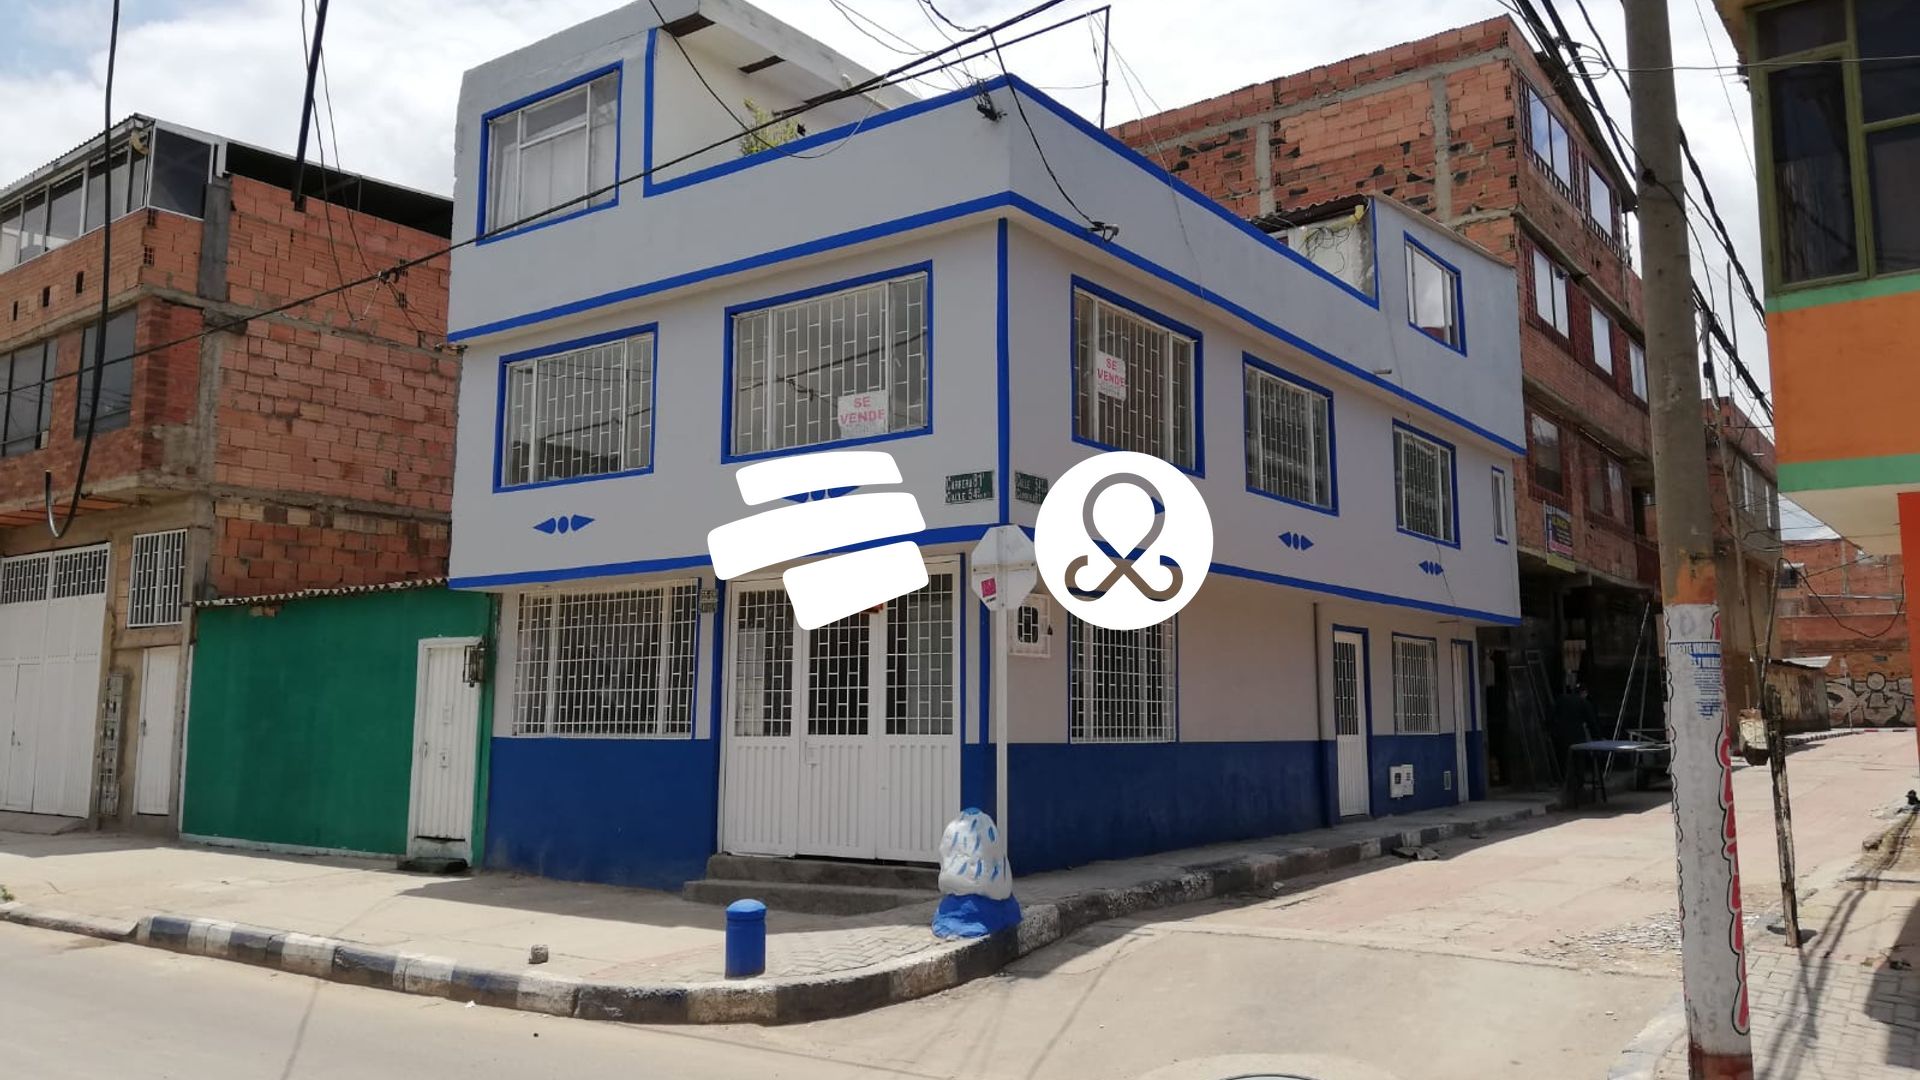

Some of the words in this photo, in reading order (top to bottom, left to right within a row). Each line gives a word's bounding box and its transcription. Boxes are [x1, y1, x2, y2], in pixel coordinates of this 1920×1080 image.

[1105, 358, 1117, 370] SE
[1097, 368, 1125, 387] VENDE
[854, 396, 871, 408] SE
[840, 409, 885, 425] VENDE
